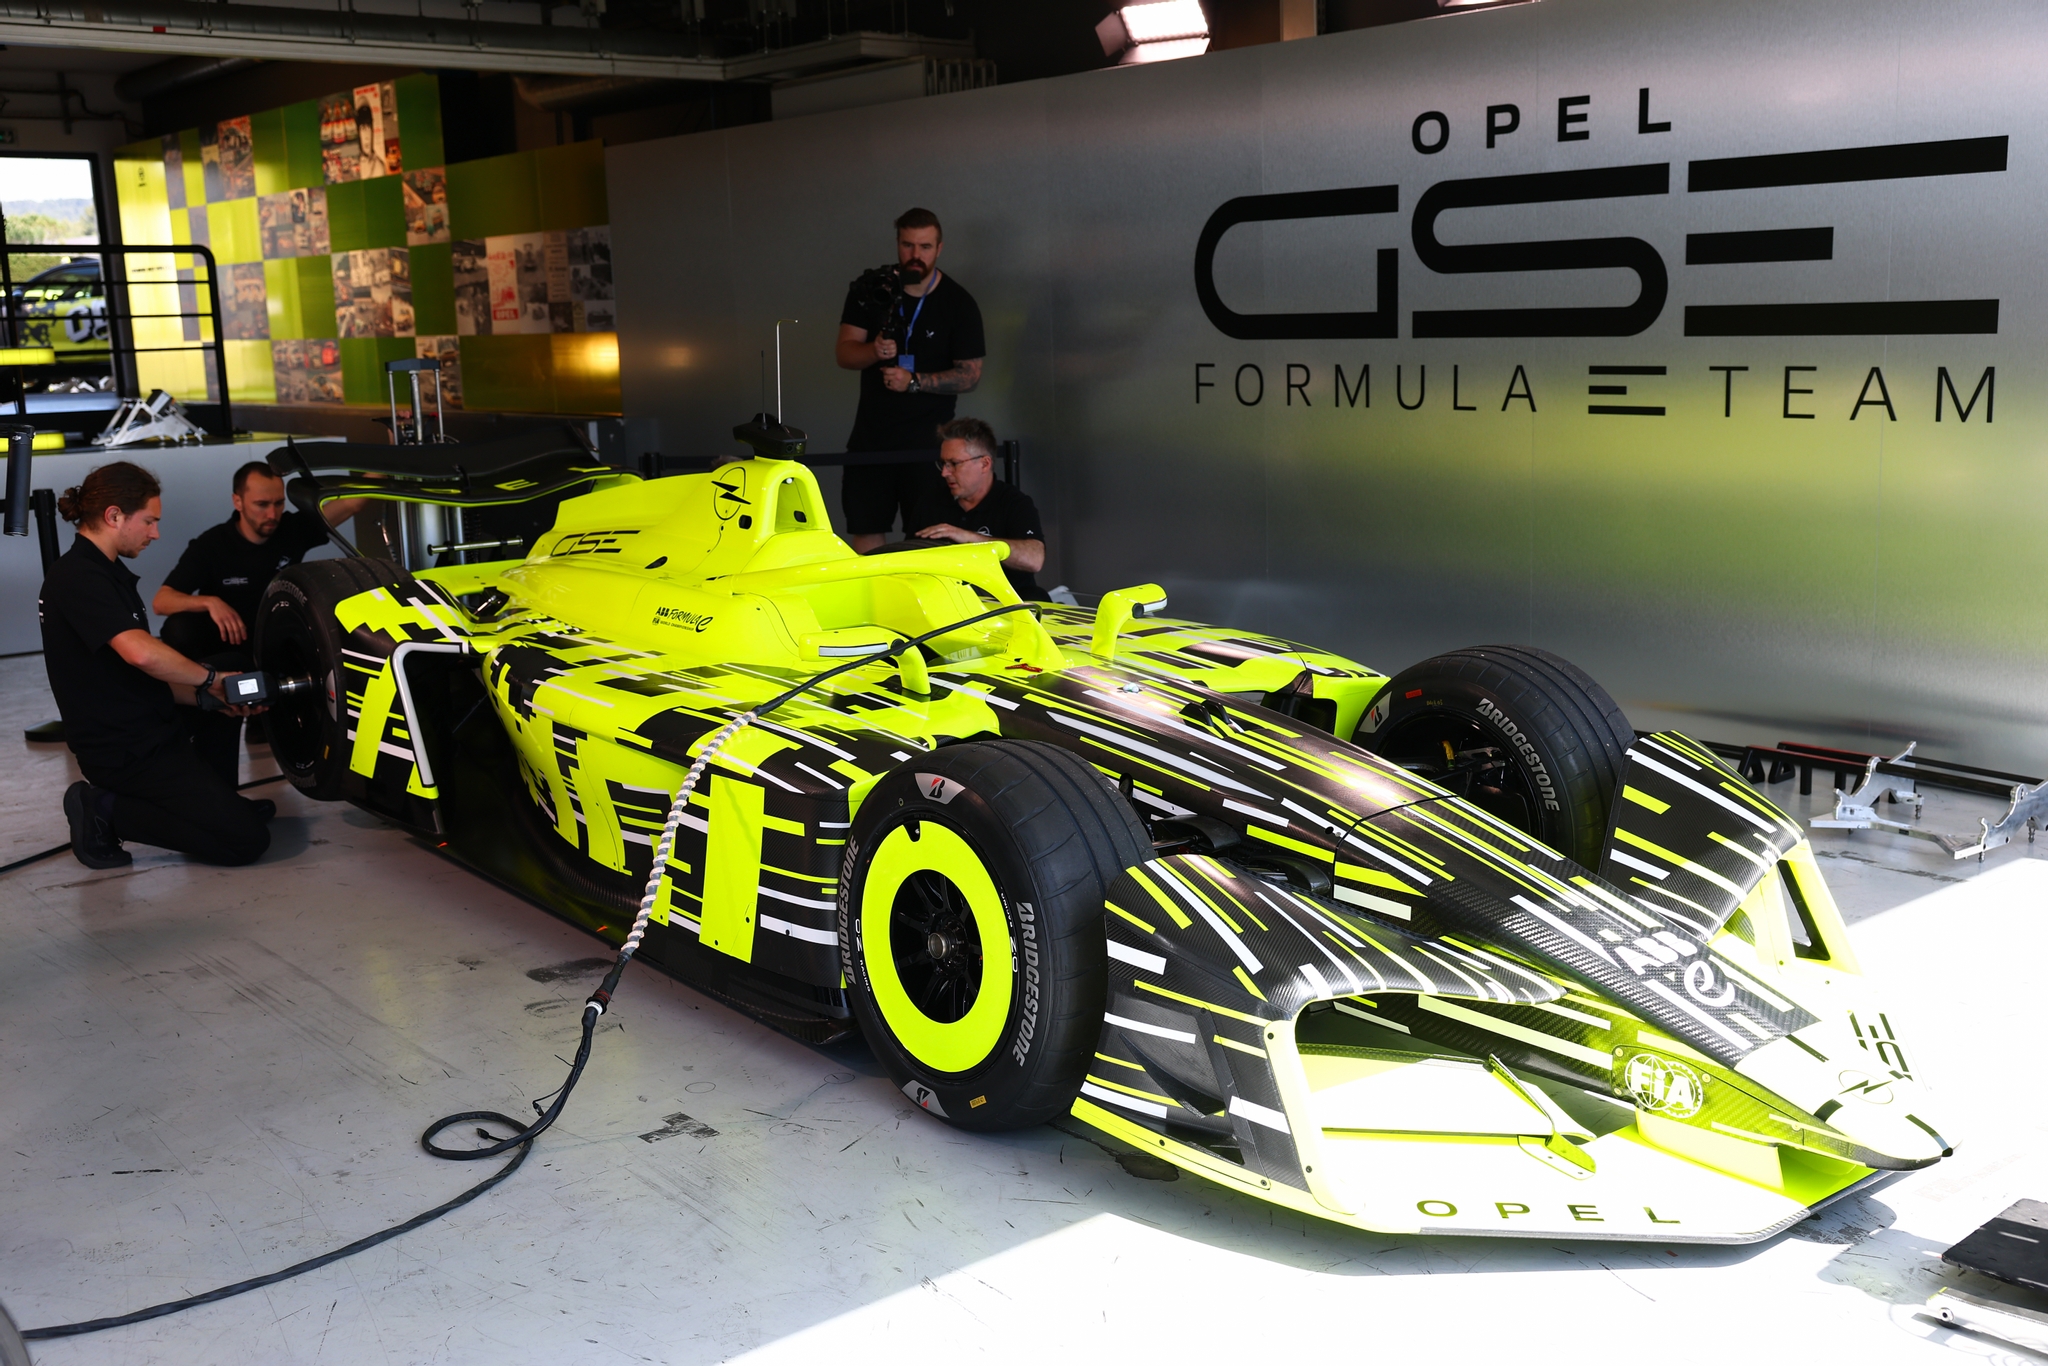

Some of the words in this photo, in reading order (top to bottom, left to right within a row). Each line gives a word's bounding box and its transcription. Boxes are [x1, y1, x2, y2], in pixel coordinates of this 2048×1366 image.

[1411, 87, 1672, 155] OPEL
[1194, 135, 2009, 341] GSE
[1195, 362, 1537, 413] FORMULA
[1709, 366, 1995, 423] TEAM
[550, 529, 641, 557] GSE
[655, 606, 670, 617] ABB
[1475, 697, 1561, 812] BRIDGESTONE
[837, 835, 859, 985] BRIDGESTONE
[859, 958, 871, 993] RACING
[1613, 930, 1698, 976] ABB
[1012, 901, 1040, 1068] BRIDGESTONE
[1416, 1199, 1682, 1225] OPEL
